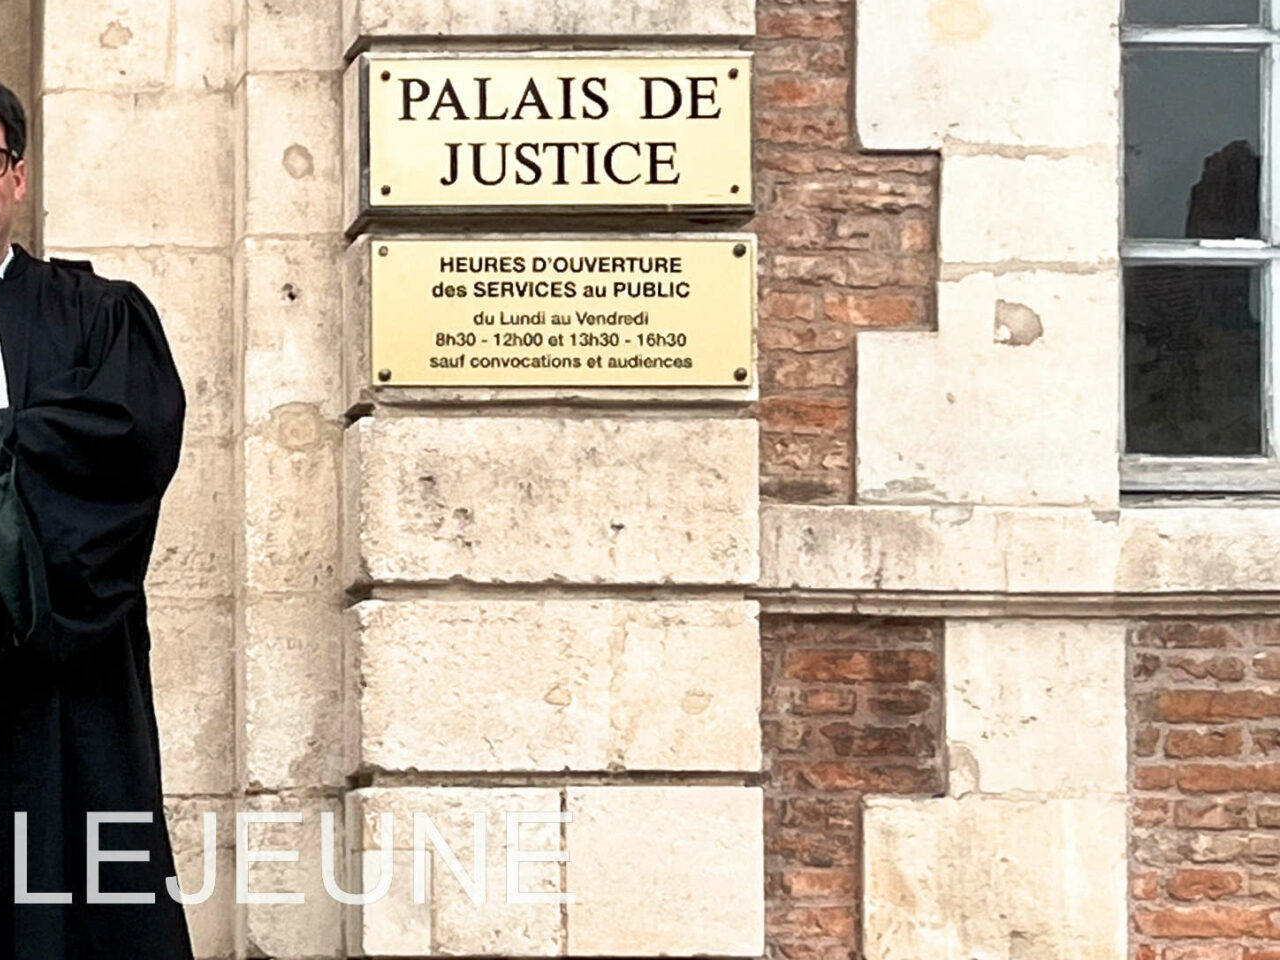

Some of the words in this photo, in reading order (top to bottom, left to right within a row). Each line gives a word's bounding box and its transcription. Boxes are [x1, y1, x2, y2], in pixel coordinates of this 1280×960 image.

[397, 76, 610, 121] PALAIS
[639, 75, 722, 121] DE
[439, 141, 681, 186] JUSTICE
[440, 256, 526, 274] HEURES
[532, 256, 683, 274] D'OUVERTURE
[431, 281, 468, 298] des
[473, 281, 577, 299] SERVICES
[582, 285, 607, 298] au
[613, 281, 690, 299] PUBLIC
[473, 311, 495, 326] du
[500, 311, 546, 326] Lundi
[551, 314, 572, 326] au
[576, 311, 649, 326] Vendredi
[435, 332, 477, 347] 8h30
[493, 332, 544, 347] 12h00
[548, 333, 564, 347] et
[570, 332, 620, 347] 13h30
[636, 332, 687, 347] 16h30
[429, 353, 466, 369] sauf
[469, 354, 583, 369] convocations
[587, 355, 603, 369] et
[607, 354, 693, 369] audiences
